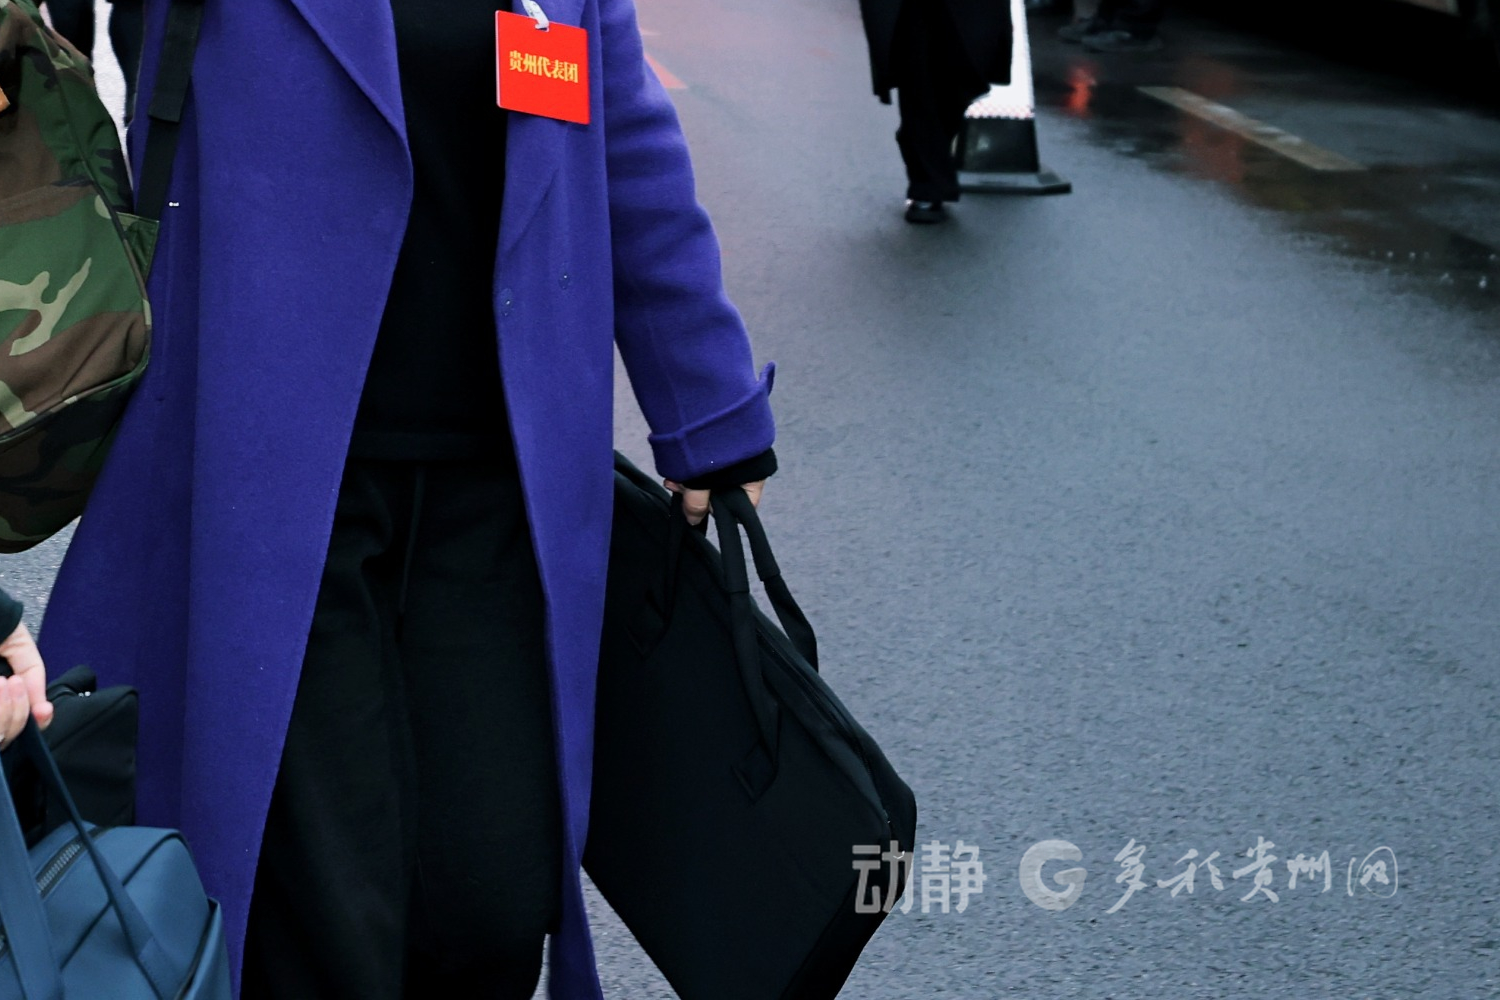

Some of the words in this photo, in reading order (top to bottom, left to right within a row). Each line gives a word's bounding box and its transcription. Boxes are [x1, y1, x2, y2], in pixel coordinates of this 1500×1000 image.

[510, 50, 578, 83] 贵州代表团
